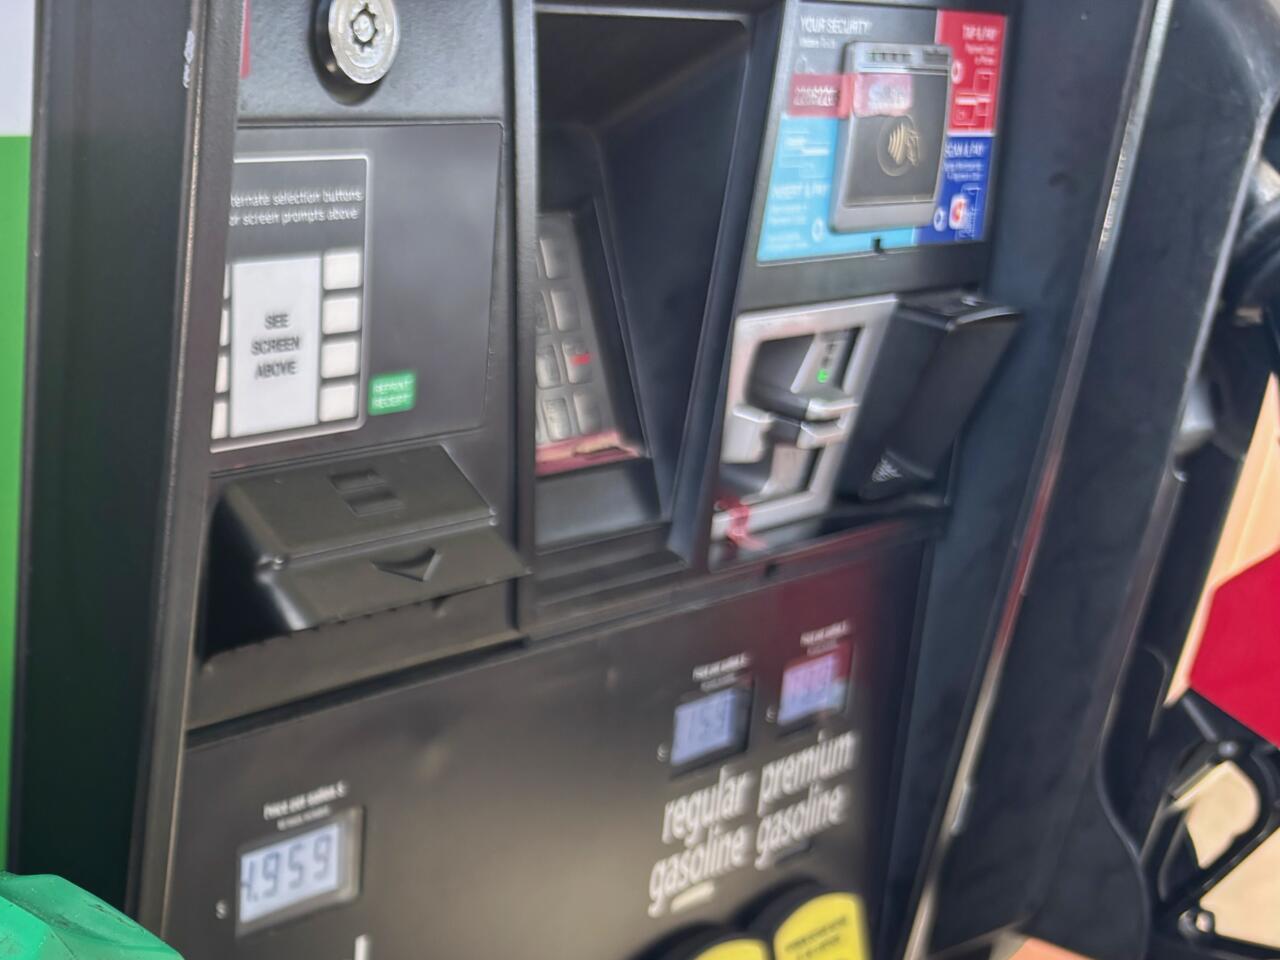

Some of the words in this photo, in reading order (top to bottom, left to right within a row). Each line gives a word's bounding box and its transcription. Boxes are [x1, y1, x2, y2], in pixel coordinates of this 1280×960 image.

[265, 312, 289, 329] SEE
[251, 336, 300, 356] SCREEN
[254, 360, 297, 380] ABOVE
[662, 763, 753, 846] regular
[757, 729, 858, 816] premium
[648, 823, 752, 917] gasoline
[755, 782, 850, 870] gasoline
